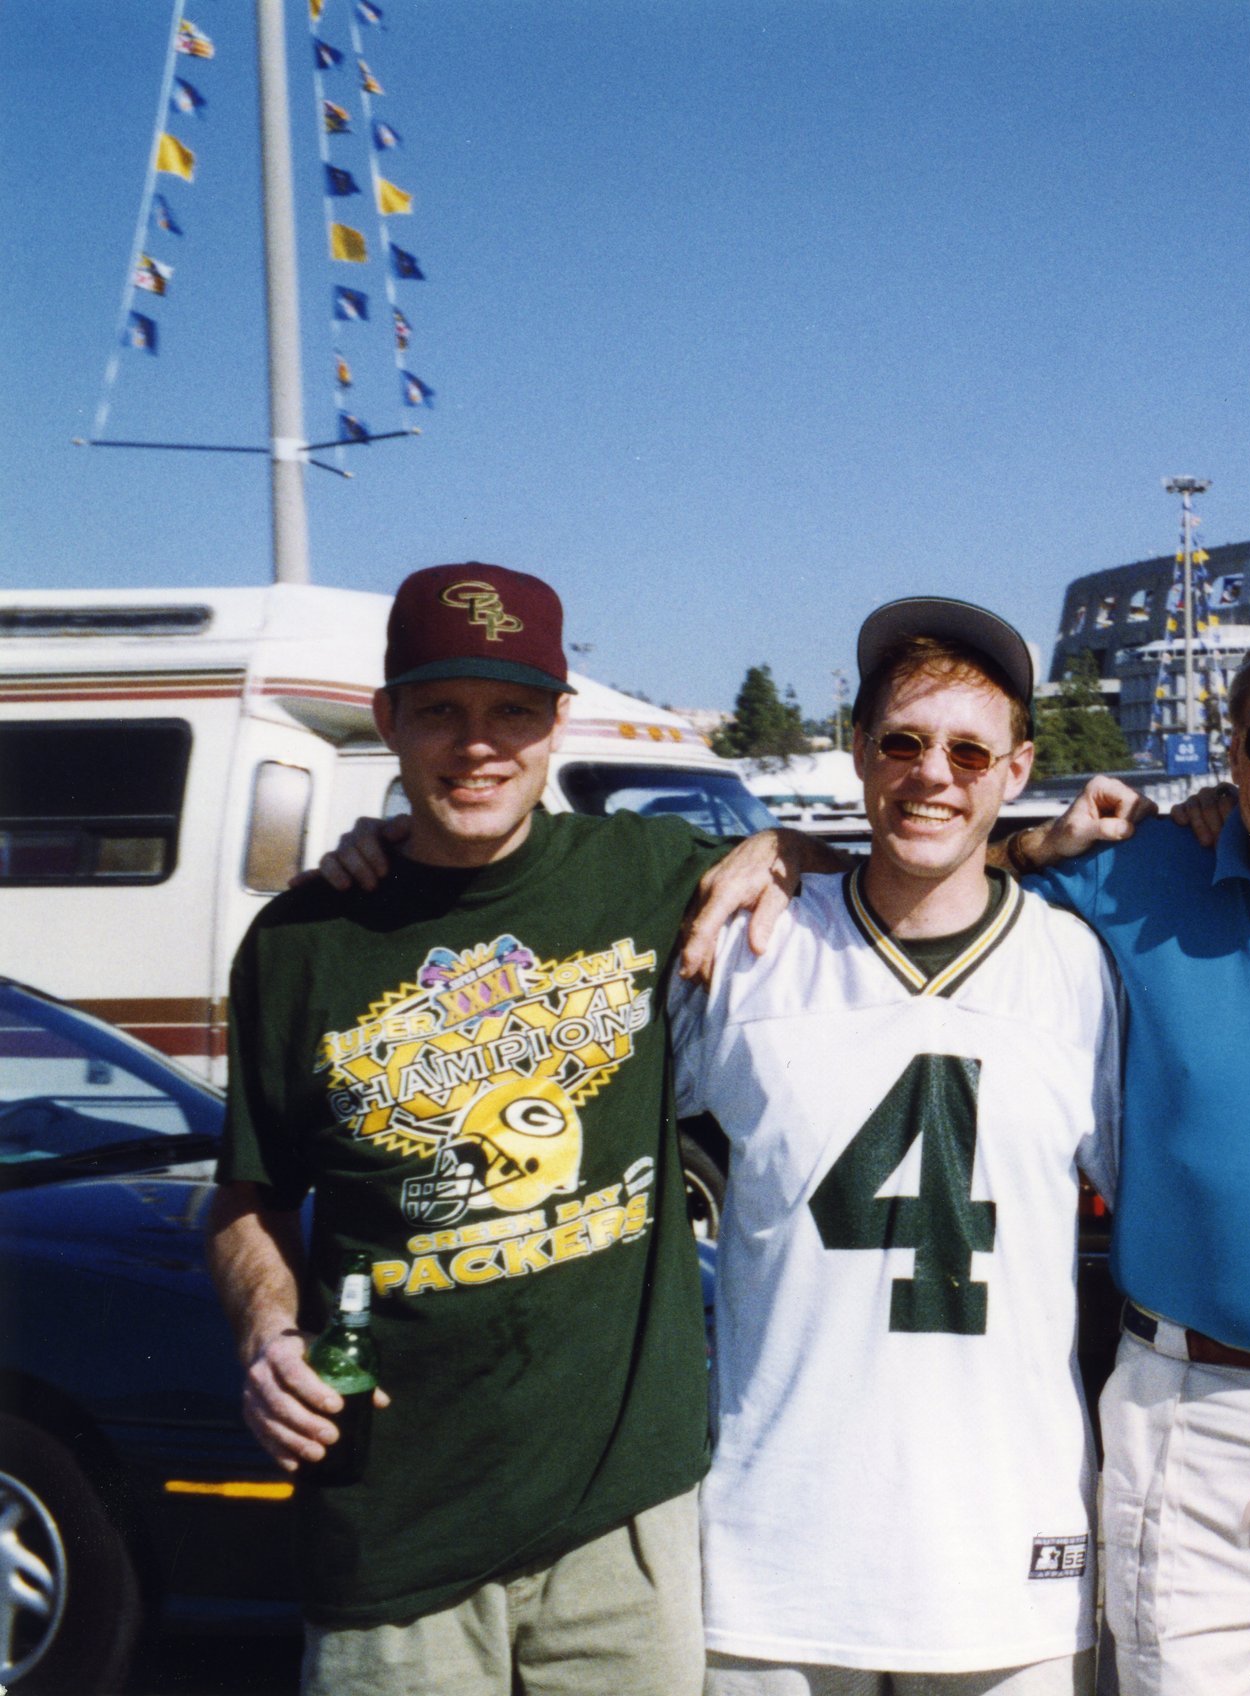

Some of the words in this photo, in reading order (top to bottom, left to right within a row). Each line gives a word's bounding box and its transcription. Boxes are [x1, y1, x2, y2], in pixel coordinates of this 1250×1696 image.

[436, 961, 524, 1030] XXXI
[313, 1010, 436, 1074] SUPER
[328, 987, 653, 1123] CHAMPIONS
[407, 1209, 547, 1255] GREEN
[556, 1182, 627, 1225] BAY
[807, 1053, 996, 1335] 4
[371, 1192, 649, 1297] PACKERS
